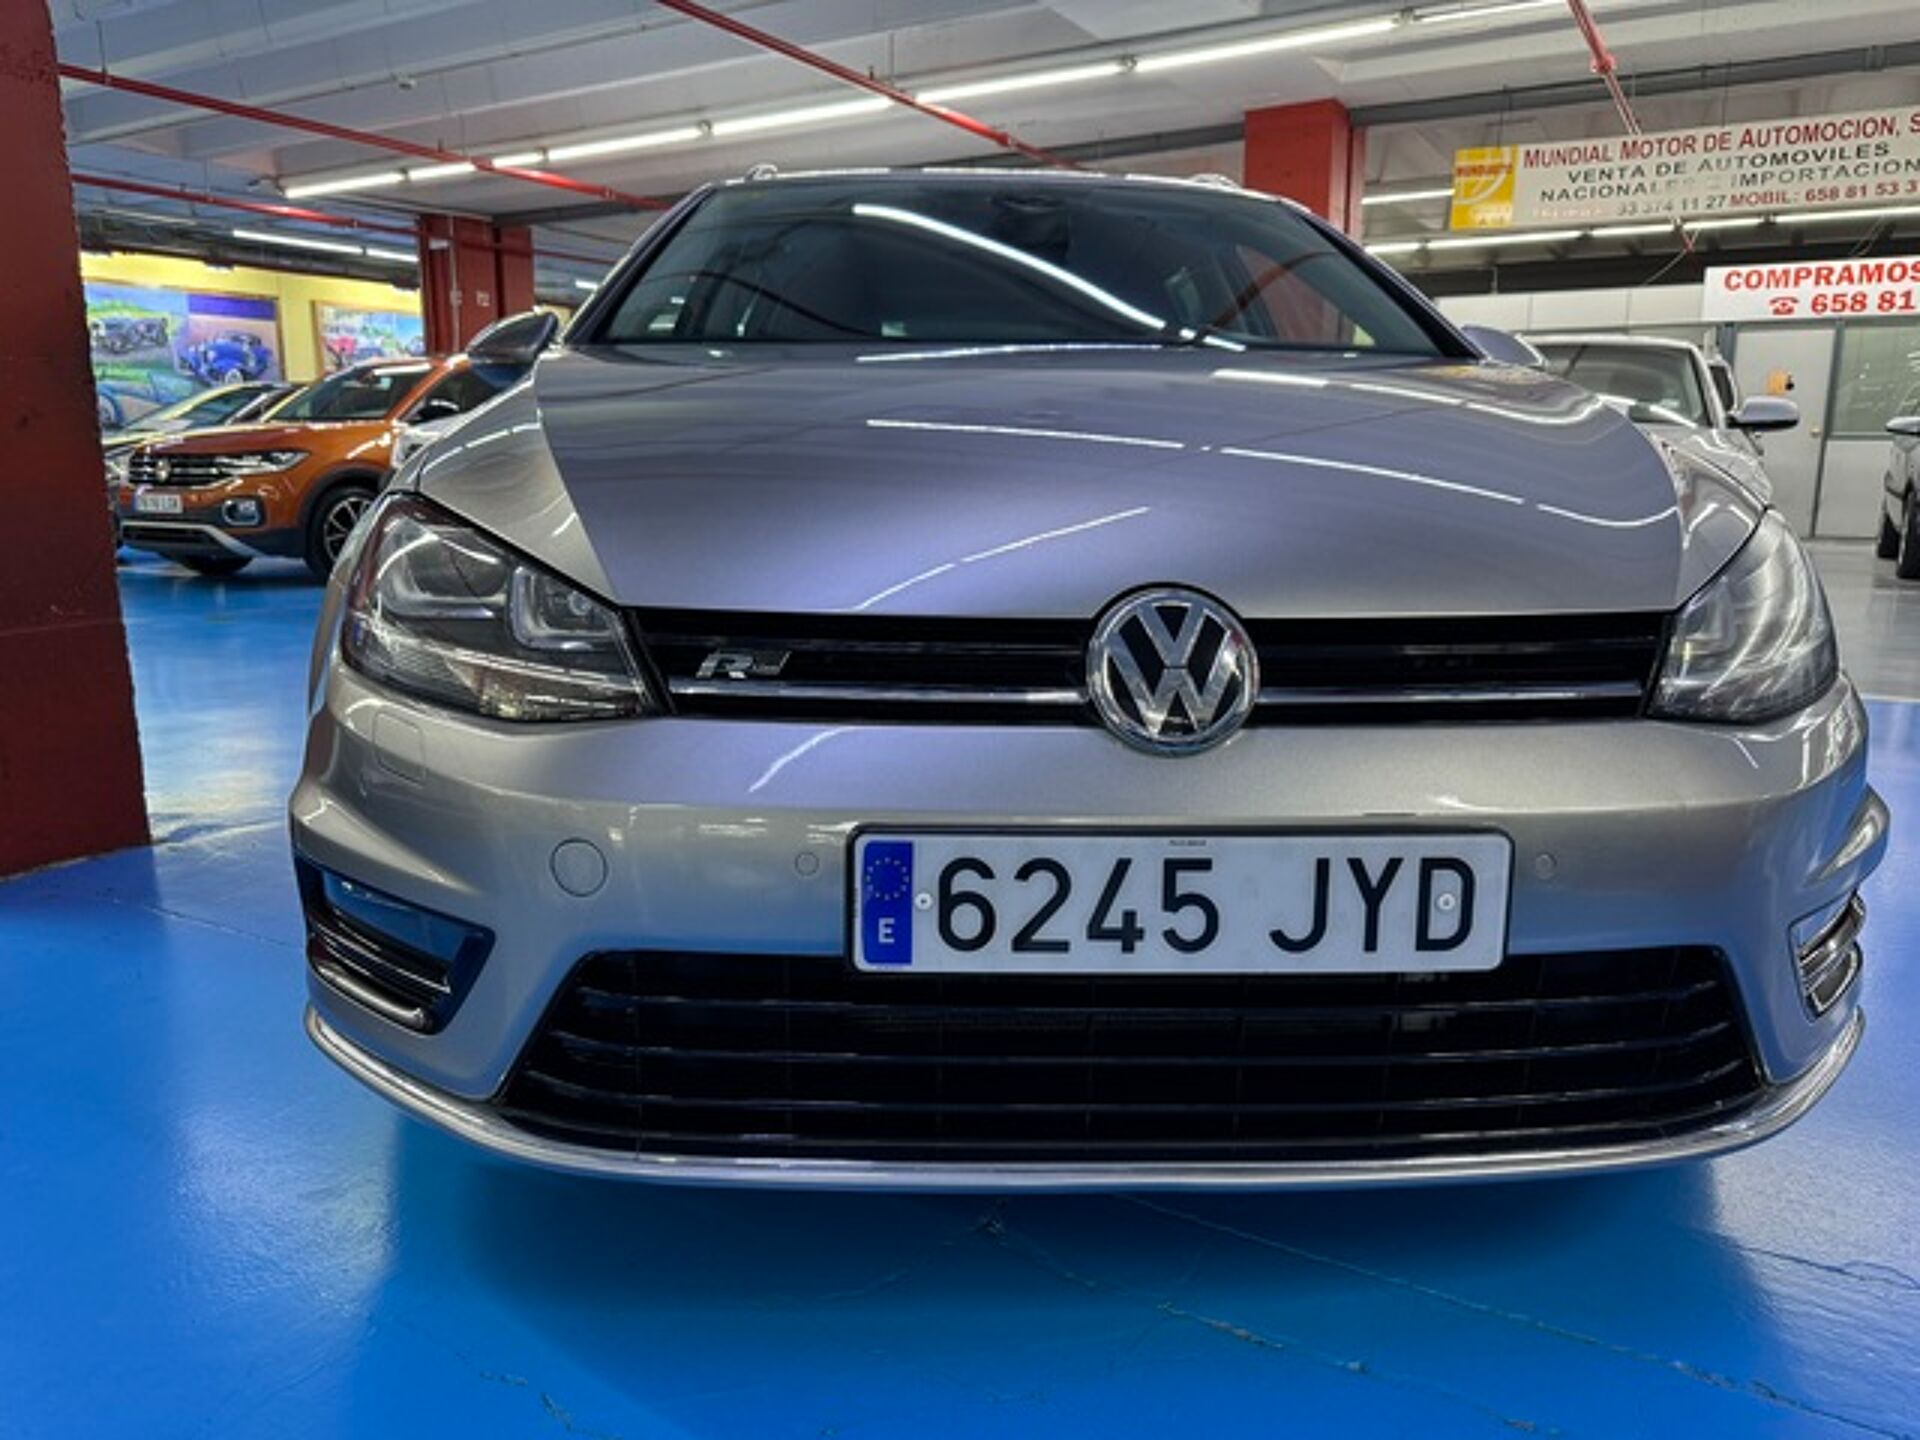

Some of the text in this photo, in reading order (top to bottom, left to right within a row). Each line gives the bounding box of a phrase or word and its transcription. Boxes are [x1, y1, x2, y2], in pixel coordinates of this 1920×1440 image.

[1523, 145, 1615, 168] MUNDIAL
[1620, 134, 1697, 161] MOTOR
[1703, 132, 1732, 151] DE
[1568, 142, 1889, 184] VENTA DE AUTOMOVILES
[1805, 186, 1840, 202] 658
[1845, 184, 1867, 199] 81
[1874, 181, 1900, 196] 53
[1724, 260, 1920, 292] COMPRAMOS
[1811, 289, 1916, 314] 658 81
[937, 856, 1477, 954] 6245 JYD
[878, 917, 896, 944] E
